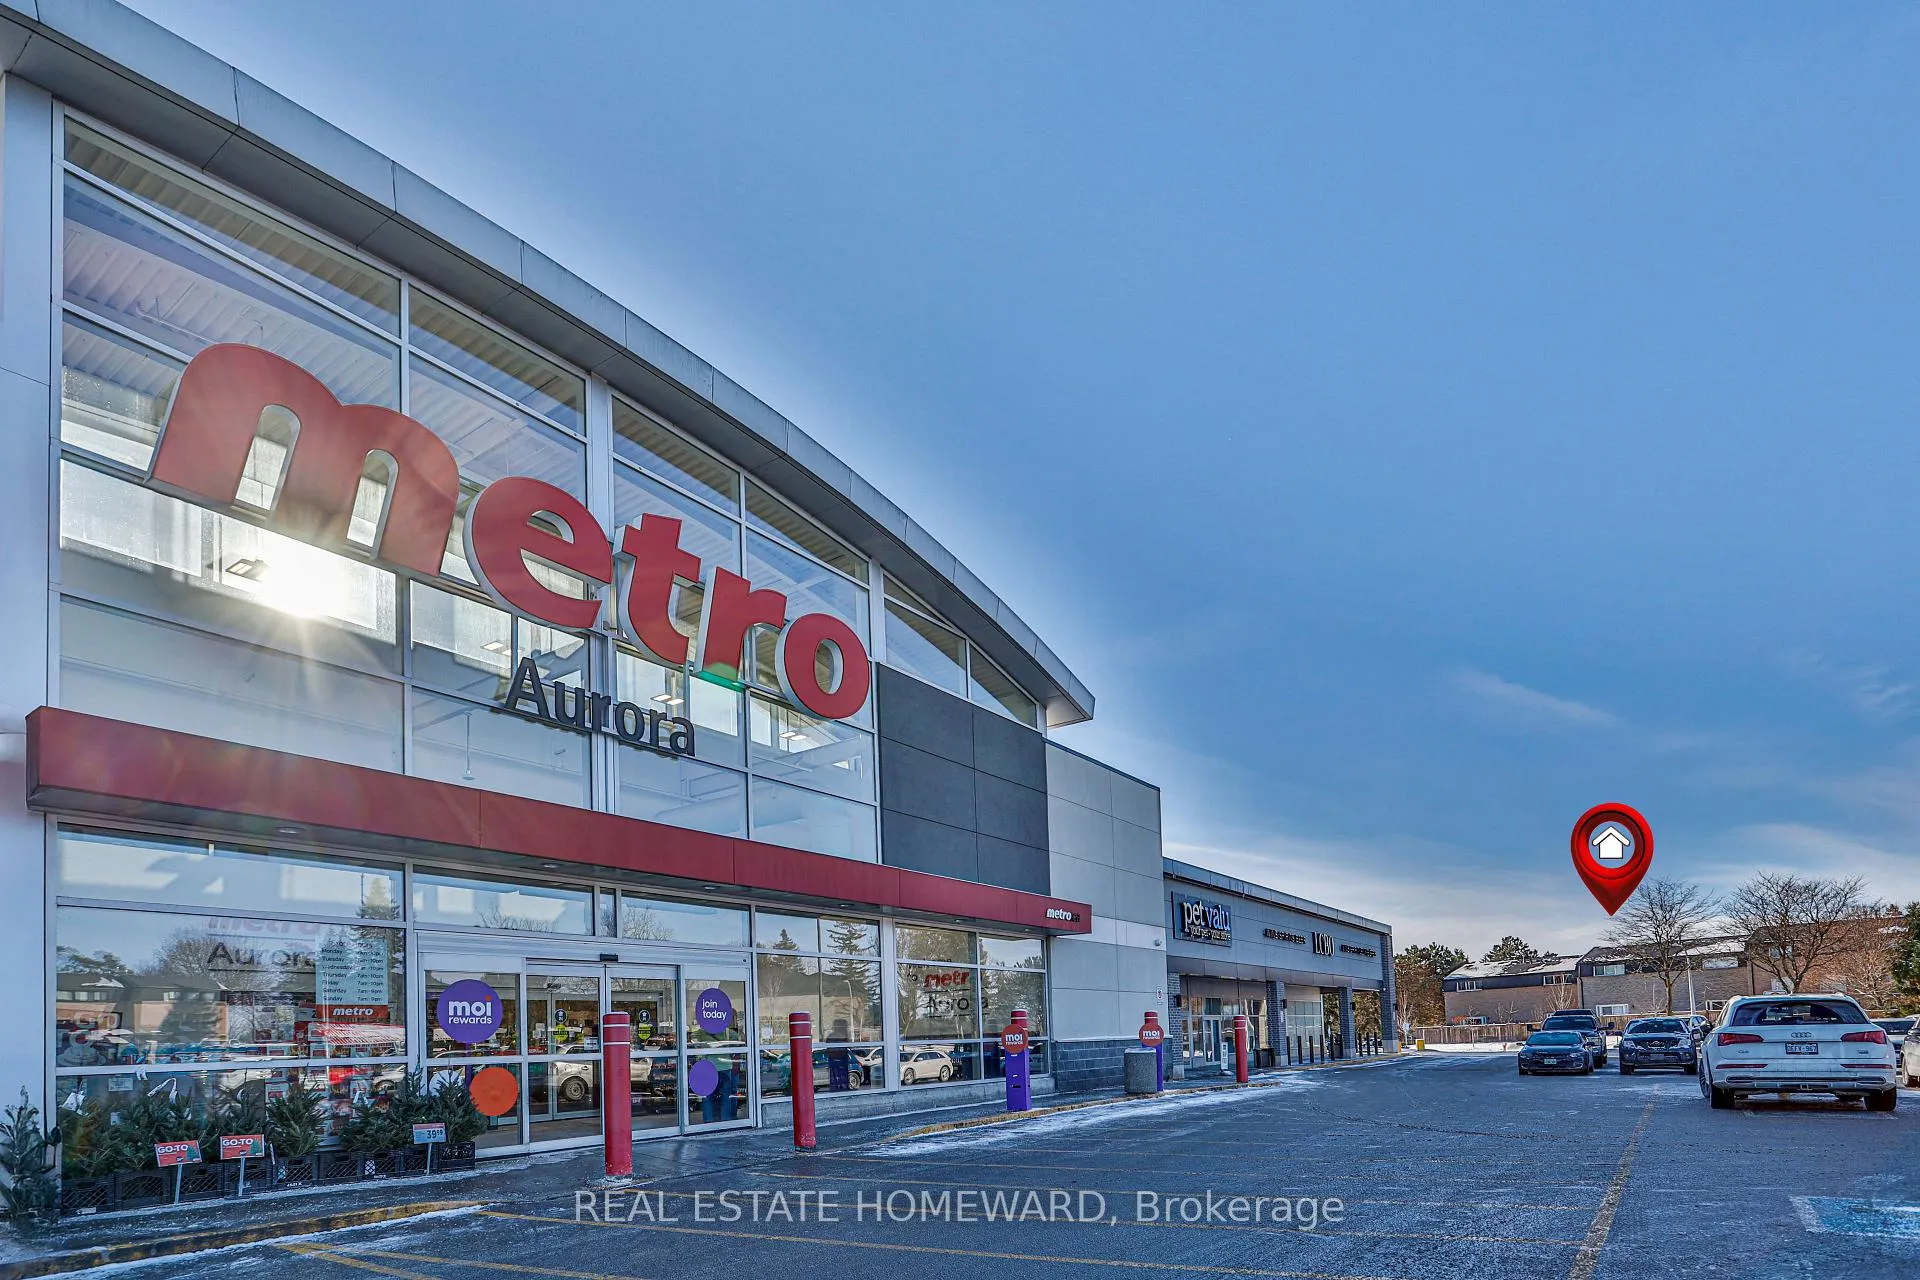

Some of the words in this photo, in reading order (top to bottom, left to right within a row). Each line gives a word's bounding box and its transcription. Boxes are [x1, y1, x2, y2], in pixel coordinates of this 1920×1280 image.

[145, 342, 870, 720] metro
[505, 657, 695, 757] Aurora
[1313, 931, 1335, 957] LCBO
[924, 969, 970, 988] metr
[448, 995, 492, 1017] moi
[702, 998, 718, 1010] join
[333, 1007, 374, 1016] metro
[702, 1009, 727, 1021] today
[448, 1016, 493, 1025] rewards
[222, 1138, 254, 1147] GO-TO
[157, 1144, 189, 1154] GO-TO
